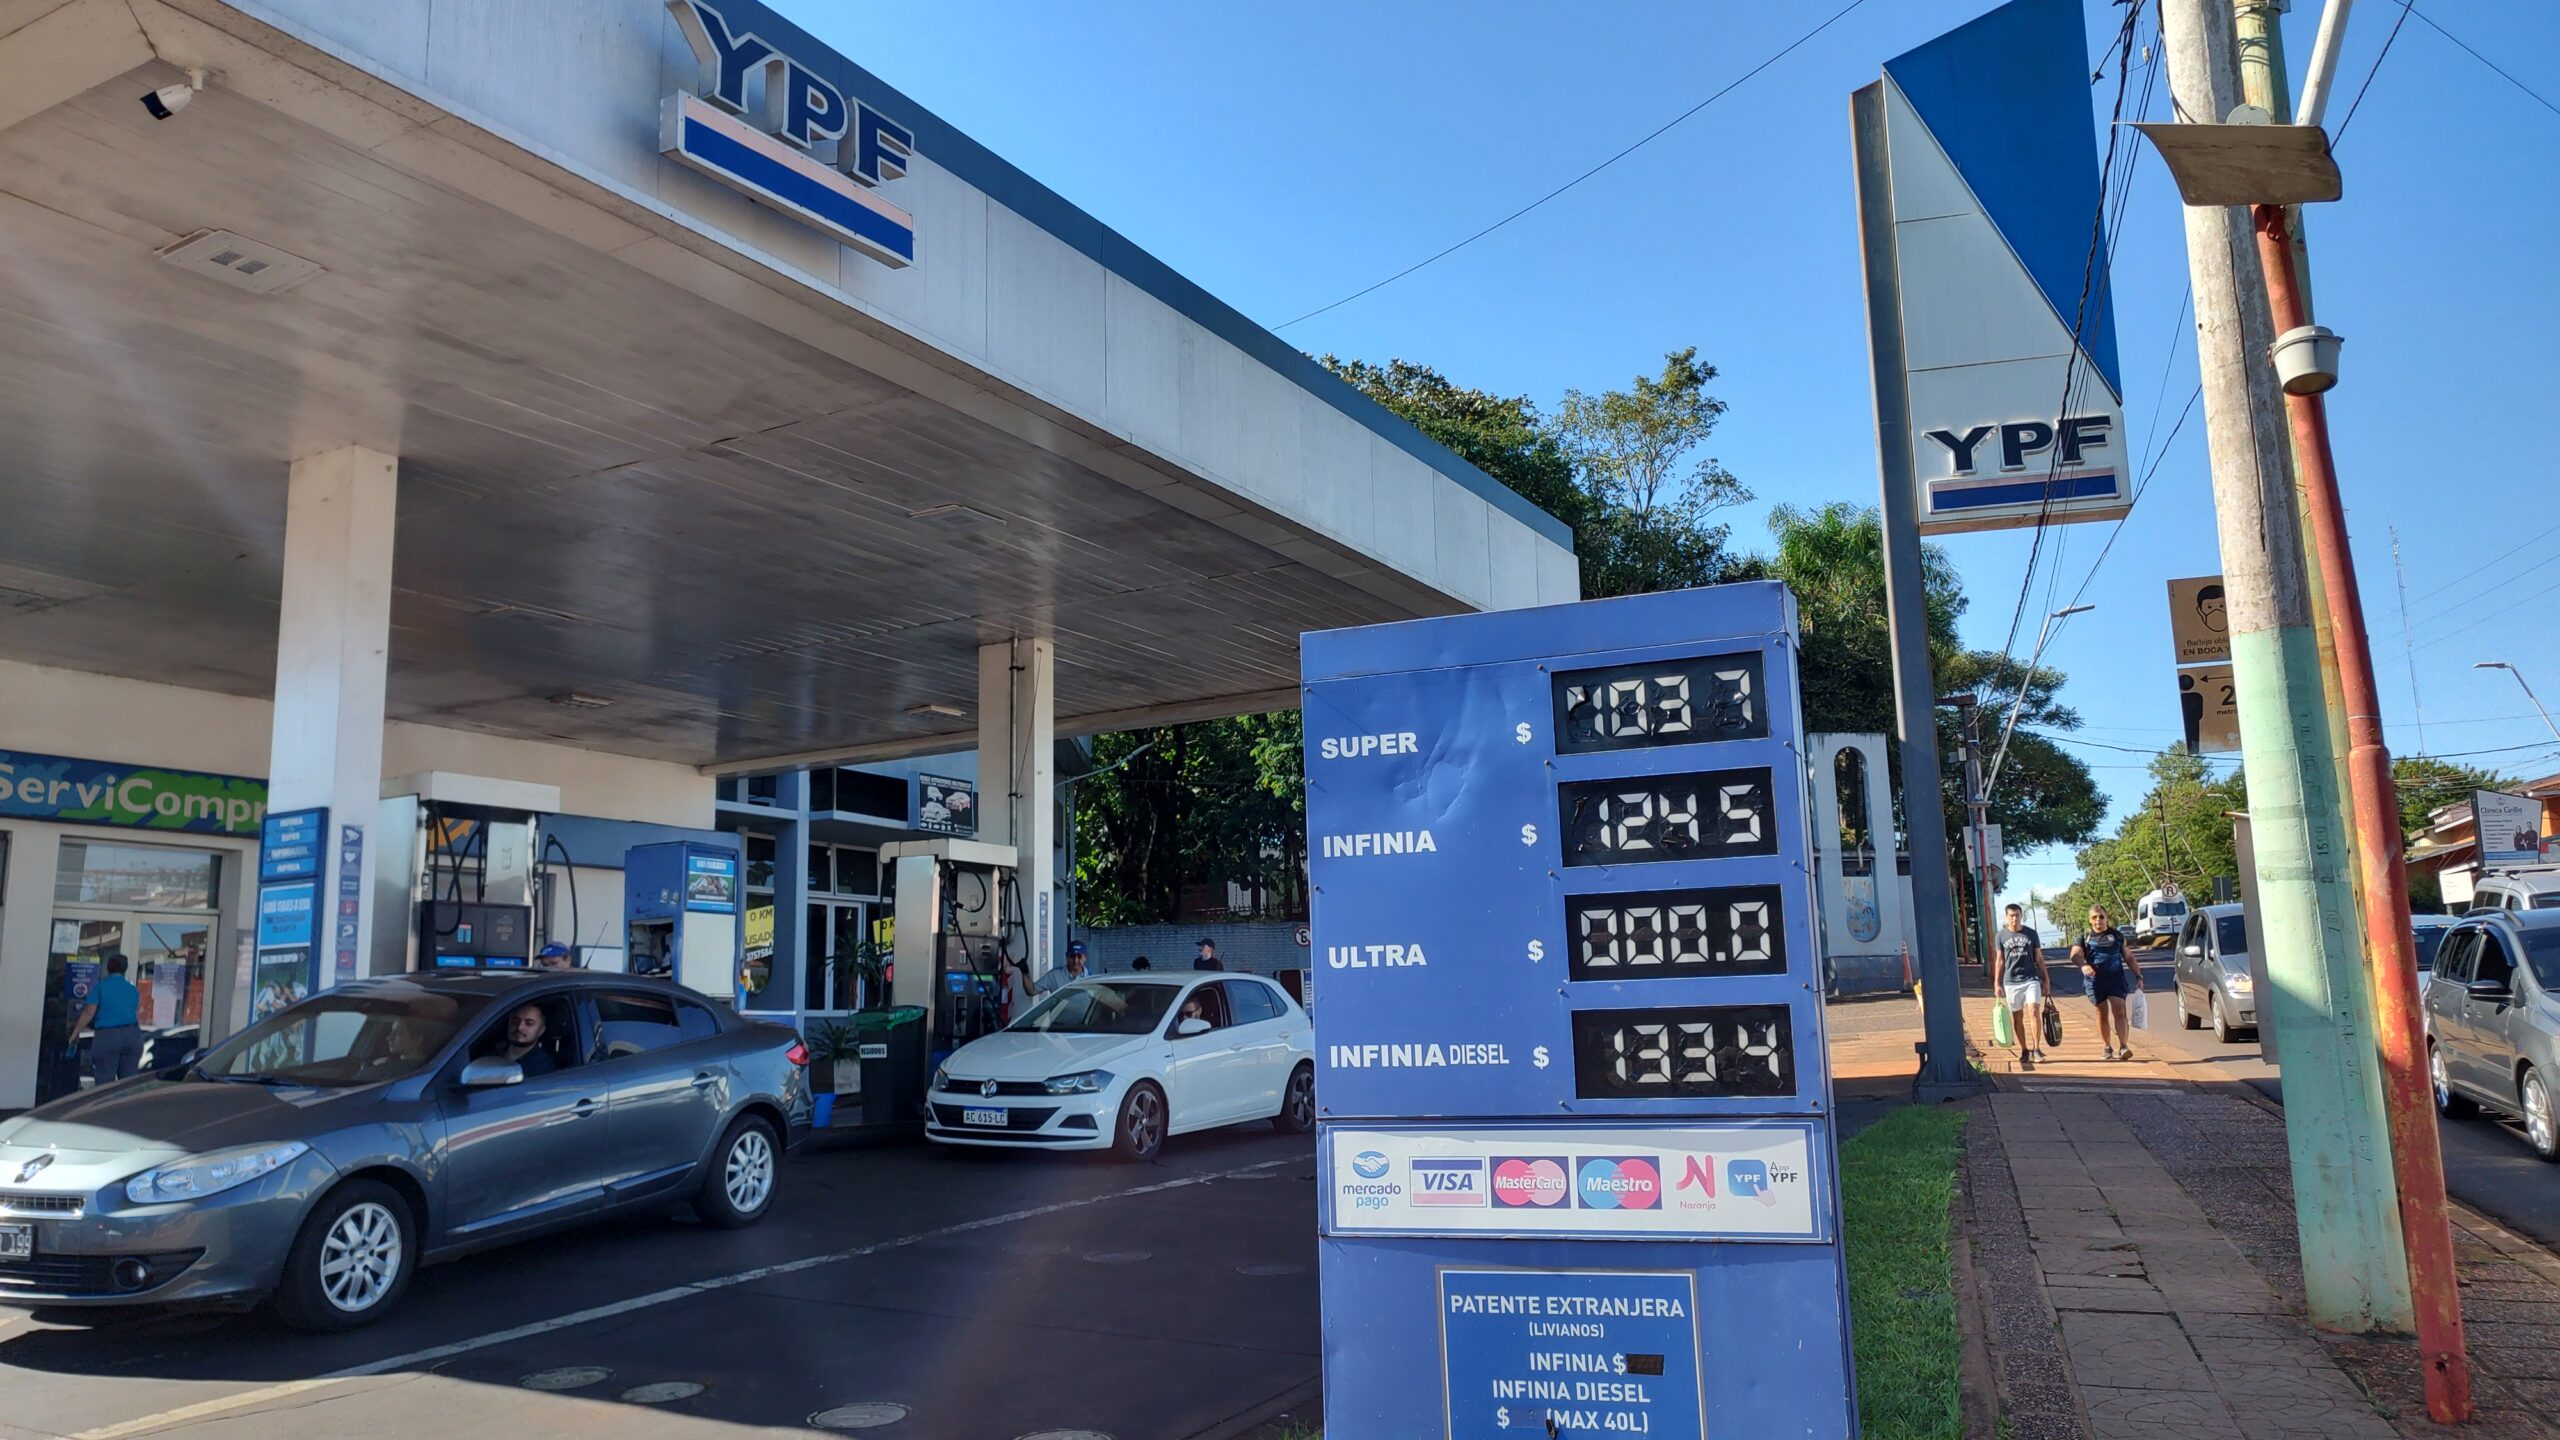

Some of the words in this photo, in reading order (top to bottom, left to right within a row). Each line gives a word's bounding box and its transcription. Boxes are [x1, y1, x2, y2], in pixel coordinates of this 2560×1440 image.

[674, 0, 914, 187] YPF
[1923, 415, 2112, 475] YPF
[2183, 648, 2196, 656] EN
[2198, 646, 2223, 655] BOCA
[2220, 685, 2236, 706] 2
[1320, 732, 1418, 760] SUPER
[1515, 721, 1533, 745] $
[1323, 830, 1437, 858] INFINIA
[1520, 824, 1538, 848] $
[759, 909, 773, 920] KM
[1329, 944, 1428, 969] ULTRA
[1527, 939, 1544, 964] $
[1580, 901, 1771, 967] 000.0
[1330, 1043, 1446, 1069] INFINIA
[1449, 1043, 1510, 1066] DIESEL
[1532, 1045, 1550, 1070] $
[1613, 1023, 1780, 1084] 1334
[1422, 1172, 1474, 1191] VISA
[1494, 1175, 1565, 1192] MasterCard
[1586, 1176, 1653, 1193] Maestro
[1734, 1174, 1762, 1183] YPF
[1769, 1172, 1798, 1183] YPF
[1342, 1182, 1401, 1195] mercado
[1355, 1197, 1389, 1209] pago
[1679, 1200, 1717, 1211] Naranja
[1450, 1295, 1541, 1315] PATENTE
[1546, 1296, 1686, 1317] EXTRANJERA
[1529, 1322, 1605, 1338] (LIVIANOS)
[1529, 1352, 1609, 1373] INFINIA
[1612, 1352, 1627, 1375] $
[1492, 1380, 1571, 1400] INFINIA
[1576, 1382, 1651, 1403] DIESEL
[1496, 1406, 1510, 1429] $
[1546, 1408, 1600, 1430] (MAX
[1604, 1411, 1649, 1434] 40L)
